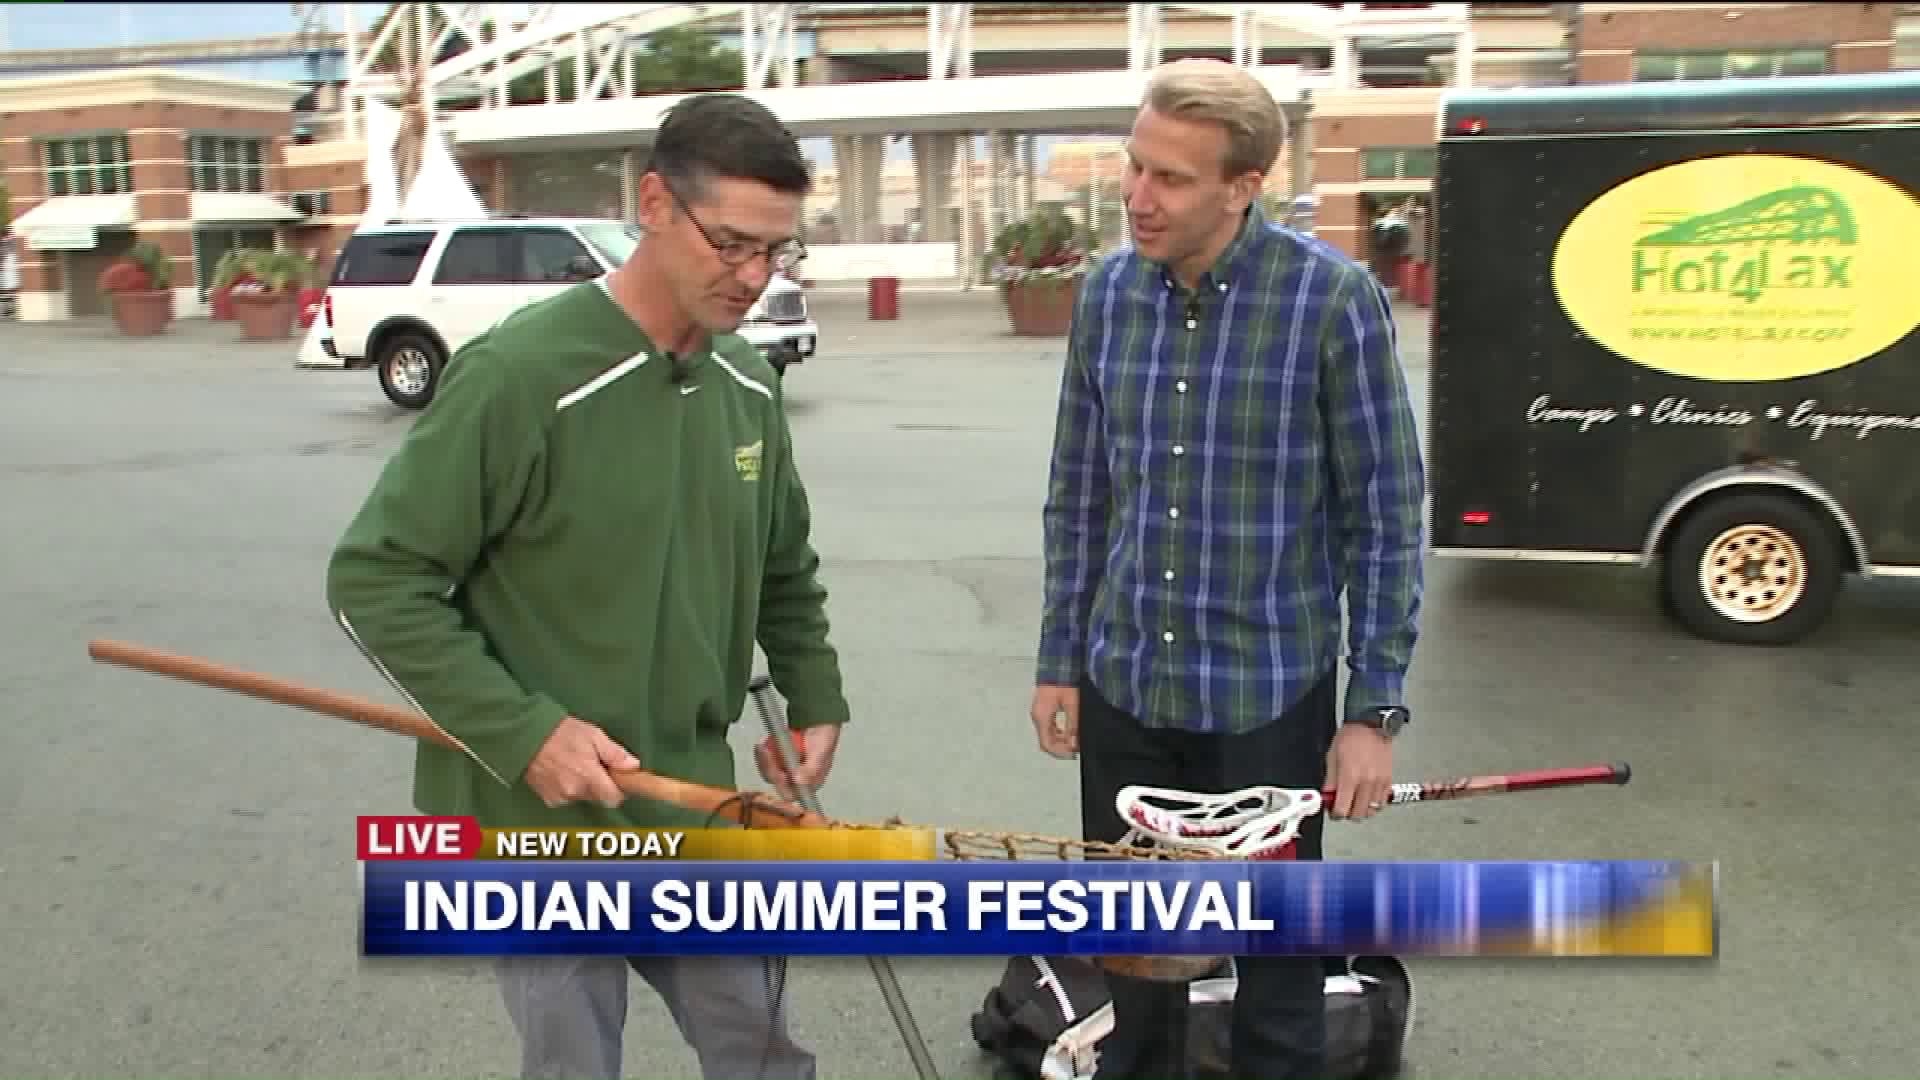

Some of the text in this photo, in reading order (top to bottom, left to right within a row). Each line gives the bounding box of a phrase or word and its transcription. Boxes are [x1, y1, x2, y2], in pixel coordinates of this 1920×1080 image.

[1632, 249, 1853, 303] Hot4Lax
[1526, 394, 1617, 432] Camps
[1650, 395, 1753, 424] Clinics
